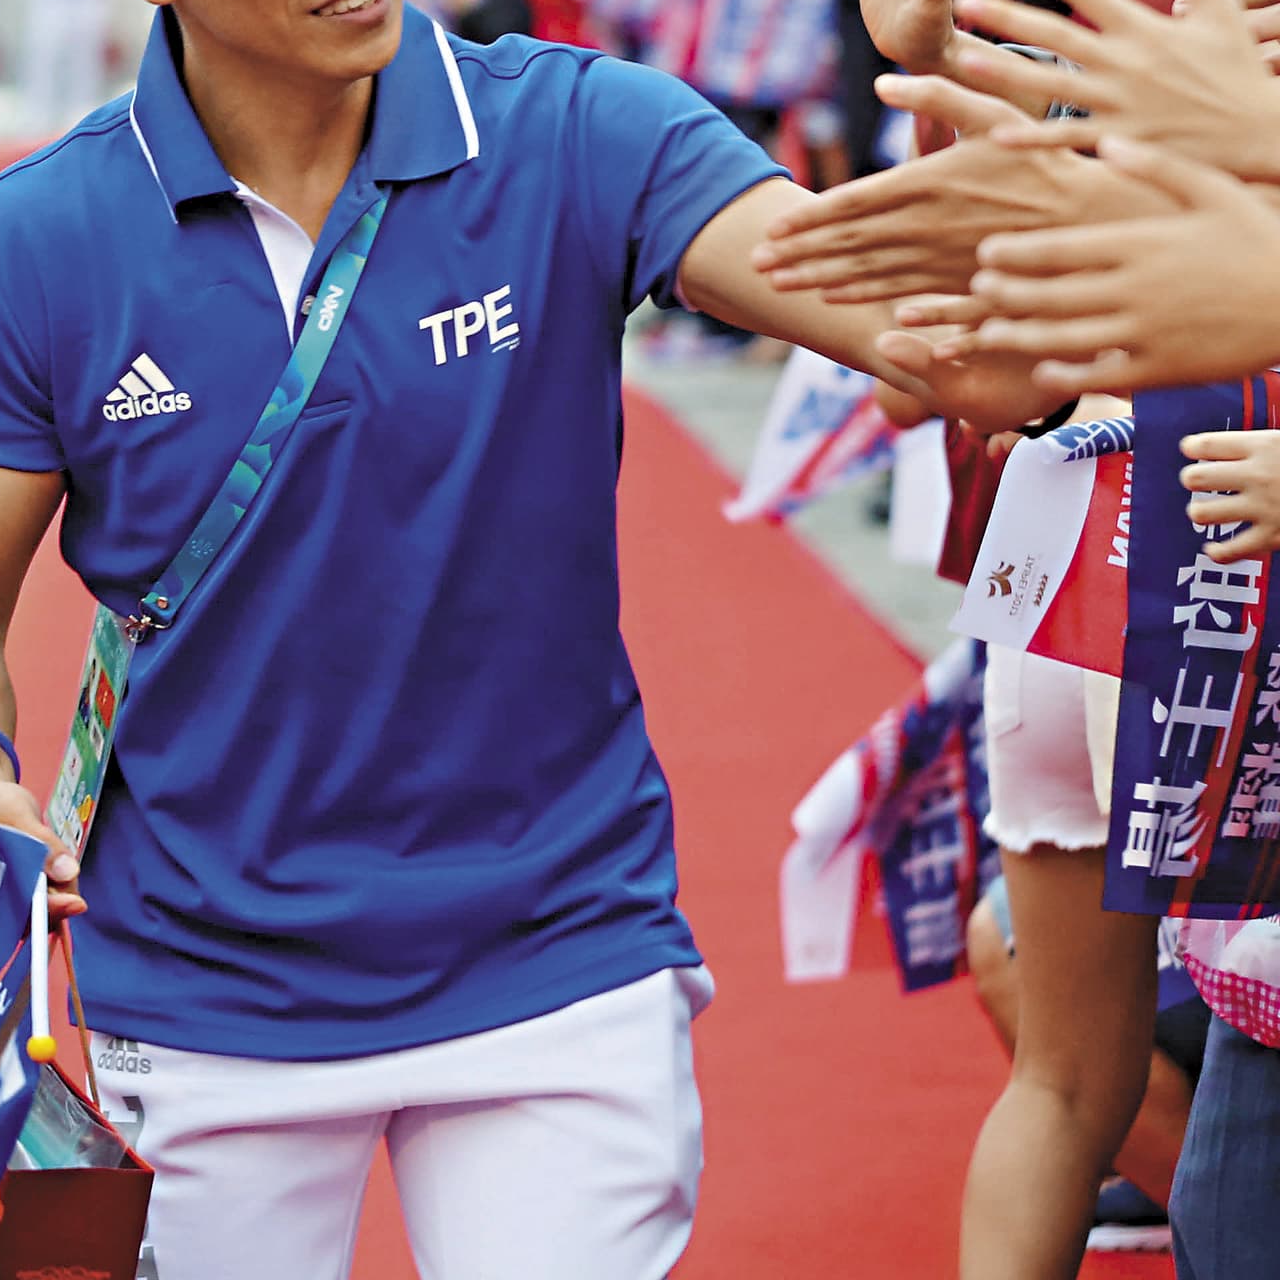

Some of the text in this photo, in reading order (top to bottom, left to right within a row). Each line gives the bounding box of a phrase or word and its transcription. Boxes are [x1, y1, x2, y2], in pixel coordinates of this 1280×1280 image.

[419, 284, 520, 366] TPE
[102, 391, 192, 421] adidas
[97, 1050, 152, 1075] adidas
